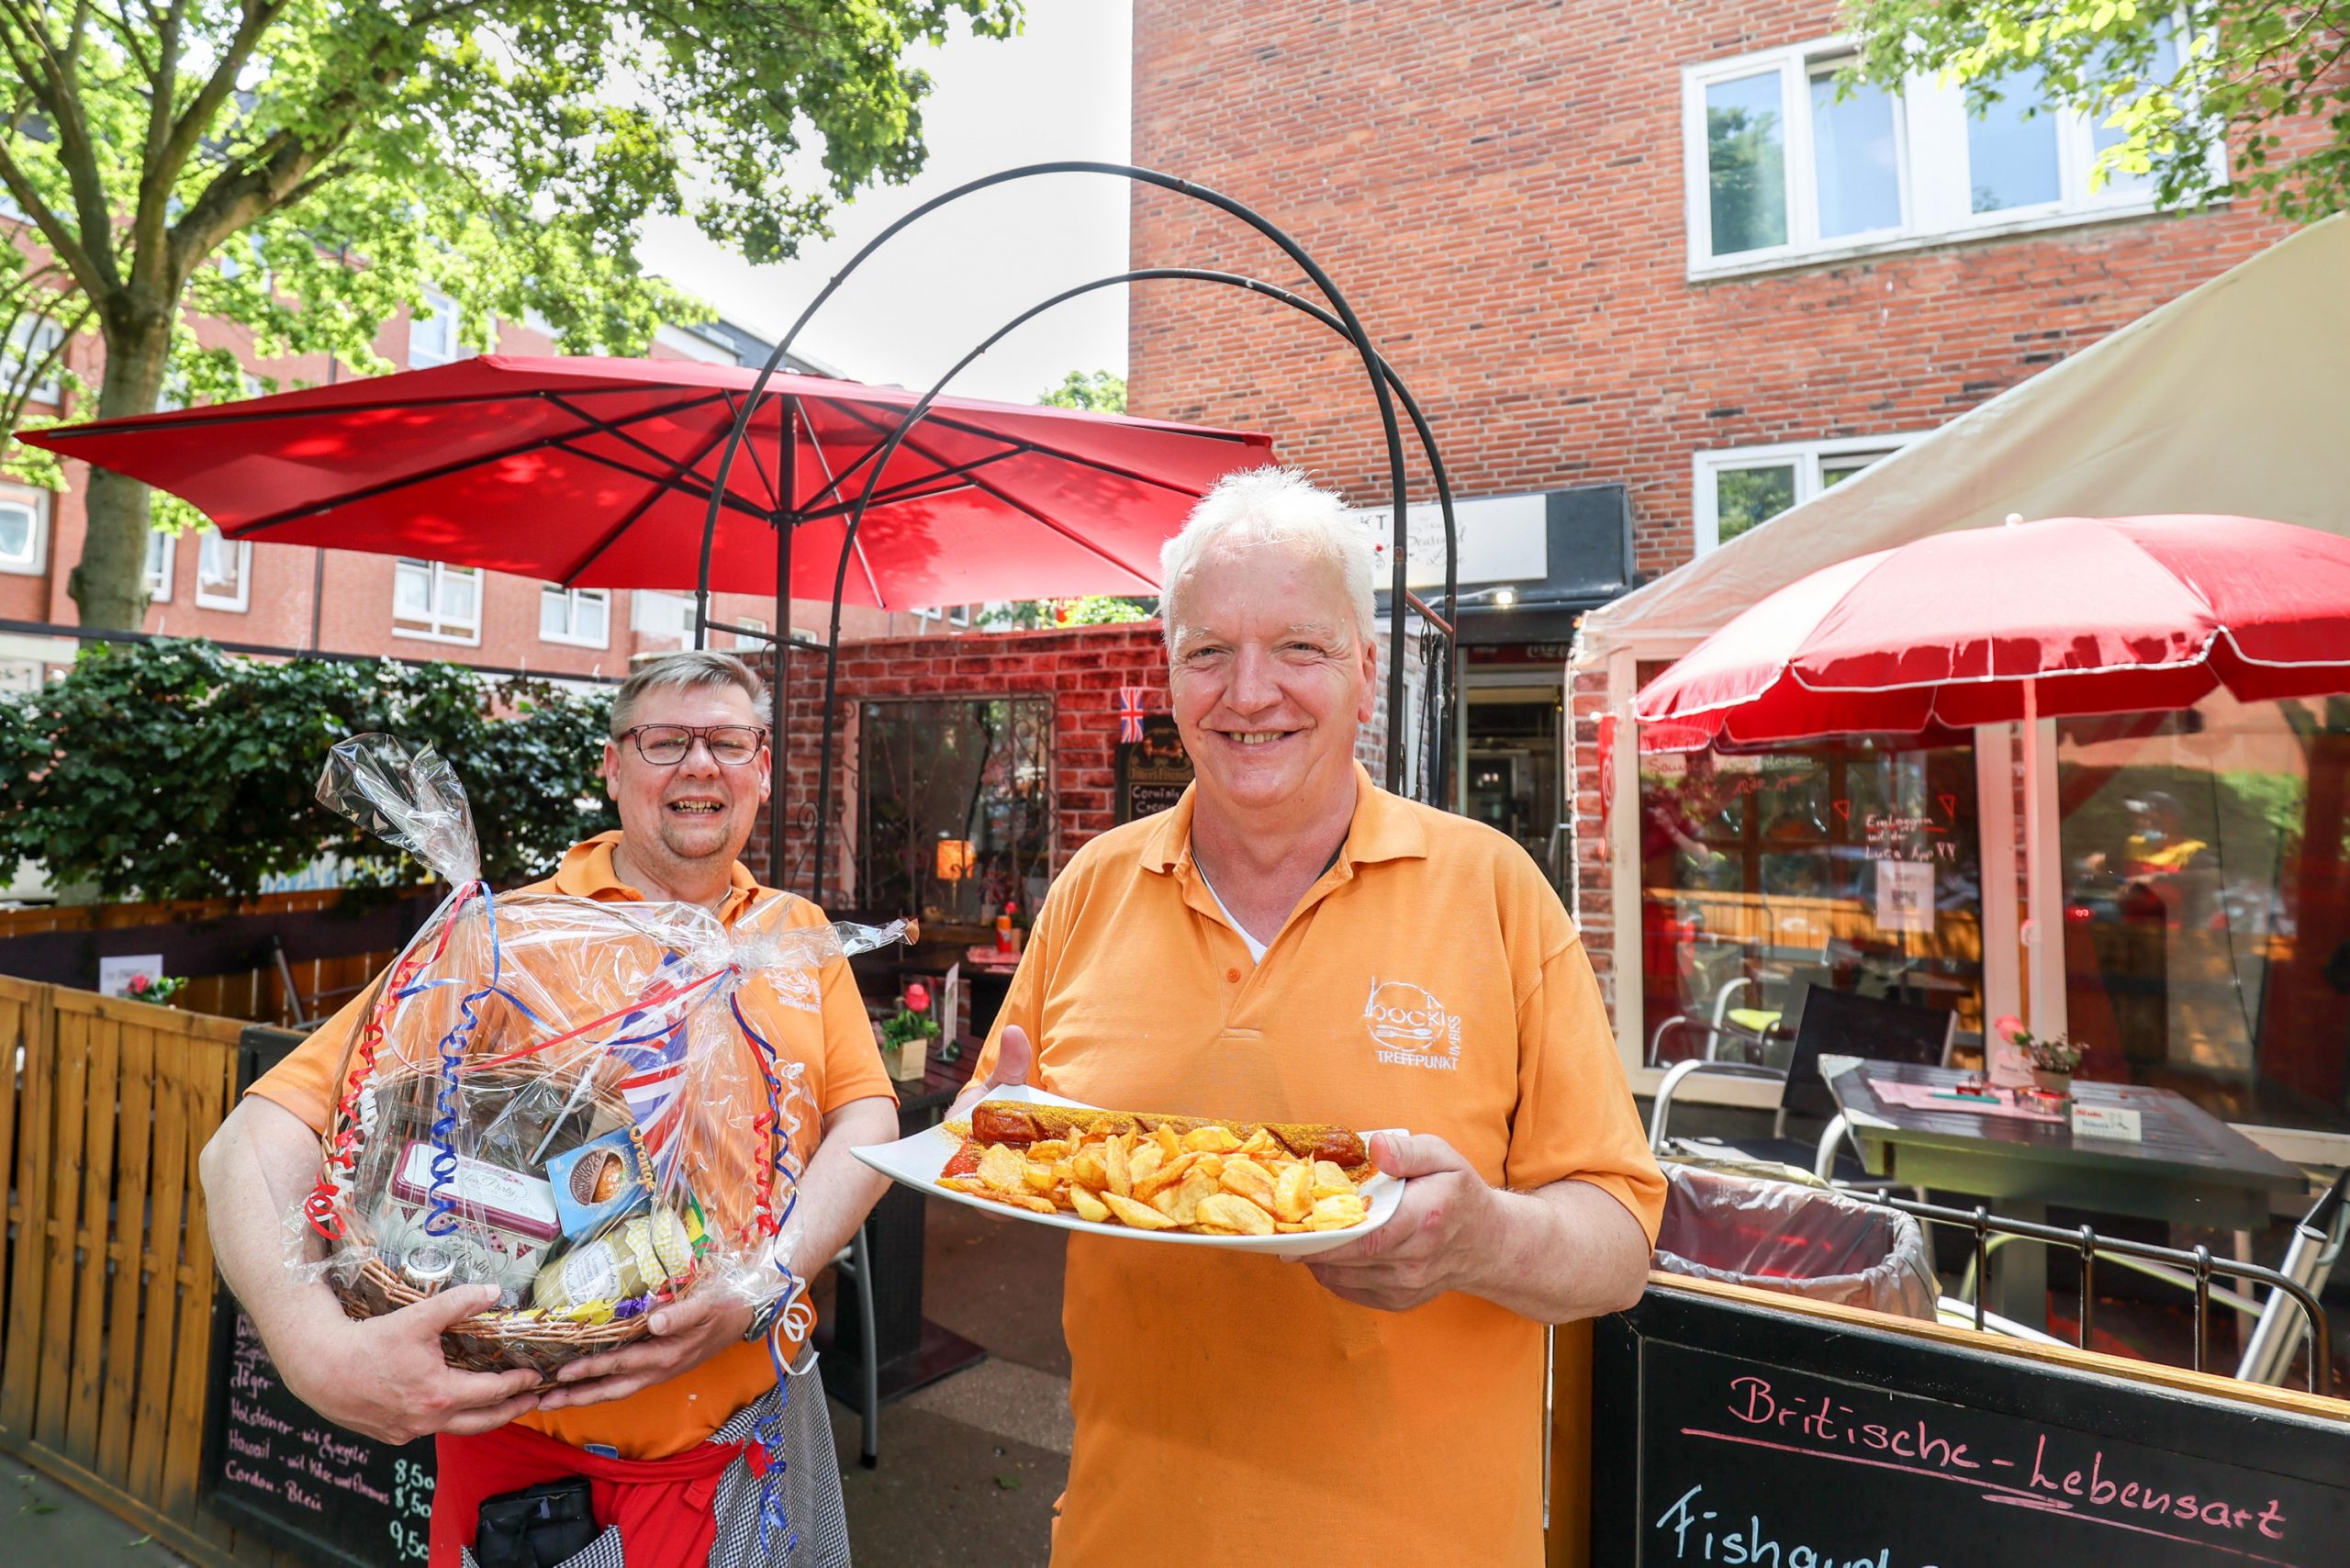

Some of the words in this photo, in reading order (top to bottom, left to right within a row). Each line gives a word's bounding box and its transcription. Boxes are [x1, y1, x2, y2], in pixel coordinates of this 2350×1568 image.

[1865, 846, 1902, 860] Luca
[1910, 844, 1934, 863] App
[1448, 1014, 1462, 1057] IMBISS
[1376, 1049, 1460, 1070] TREFFPUNKT
[629, 1125, 656, 1193] Orange
[230, 1395, 295, 1435] Holsteiner
[394, 1458, 436, 1492] 8,50
[224, 1460, 275, 1494] Cordon
[394, 1486, 432, 1518] 8,50
